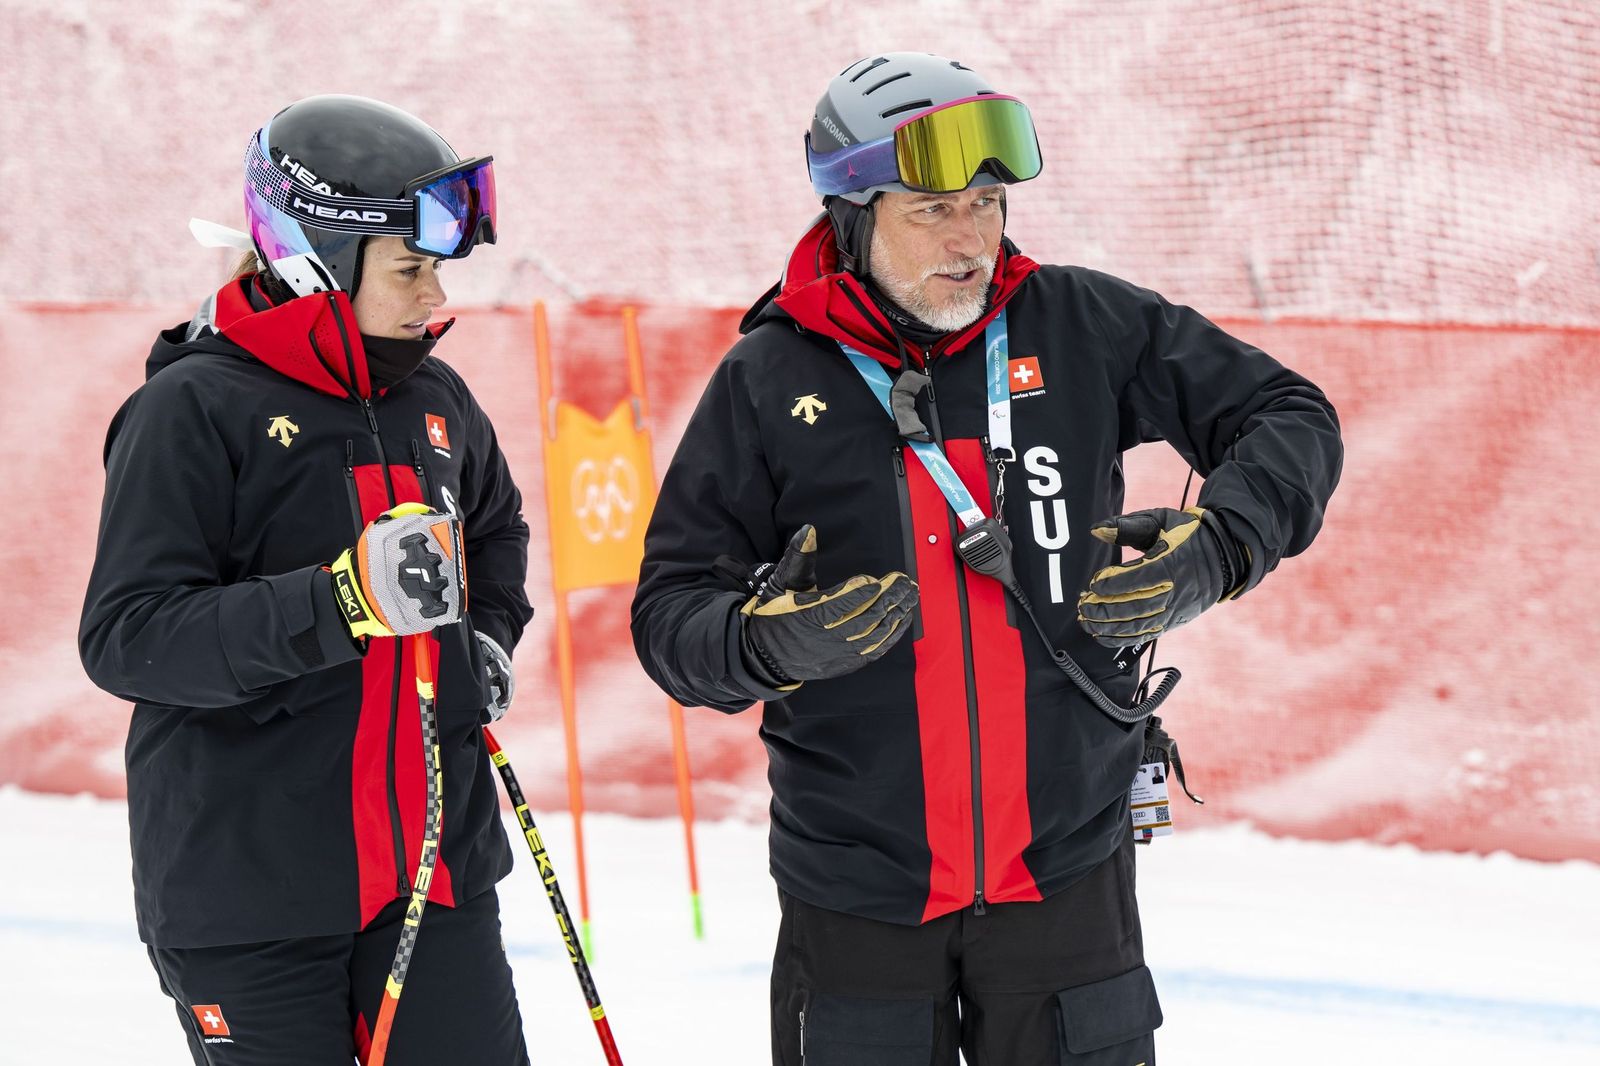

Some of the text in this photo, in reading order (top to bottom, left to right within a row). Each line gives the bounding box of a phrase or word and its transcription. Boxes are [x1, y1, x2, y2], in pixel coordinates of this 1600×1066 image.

[822, 116, 850, 147] ATOMIC
[280, 154, 345, 197] HEA
[293, 197, 388, 223] HEAD
[1023, 446, 1071, 604] SUI
[335, 572, 362, 617] LEKI
[515, 803, 557, 886] LEKI
[404, 839, 438, 927] LEKI
